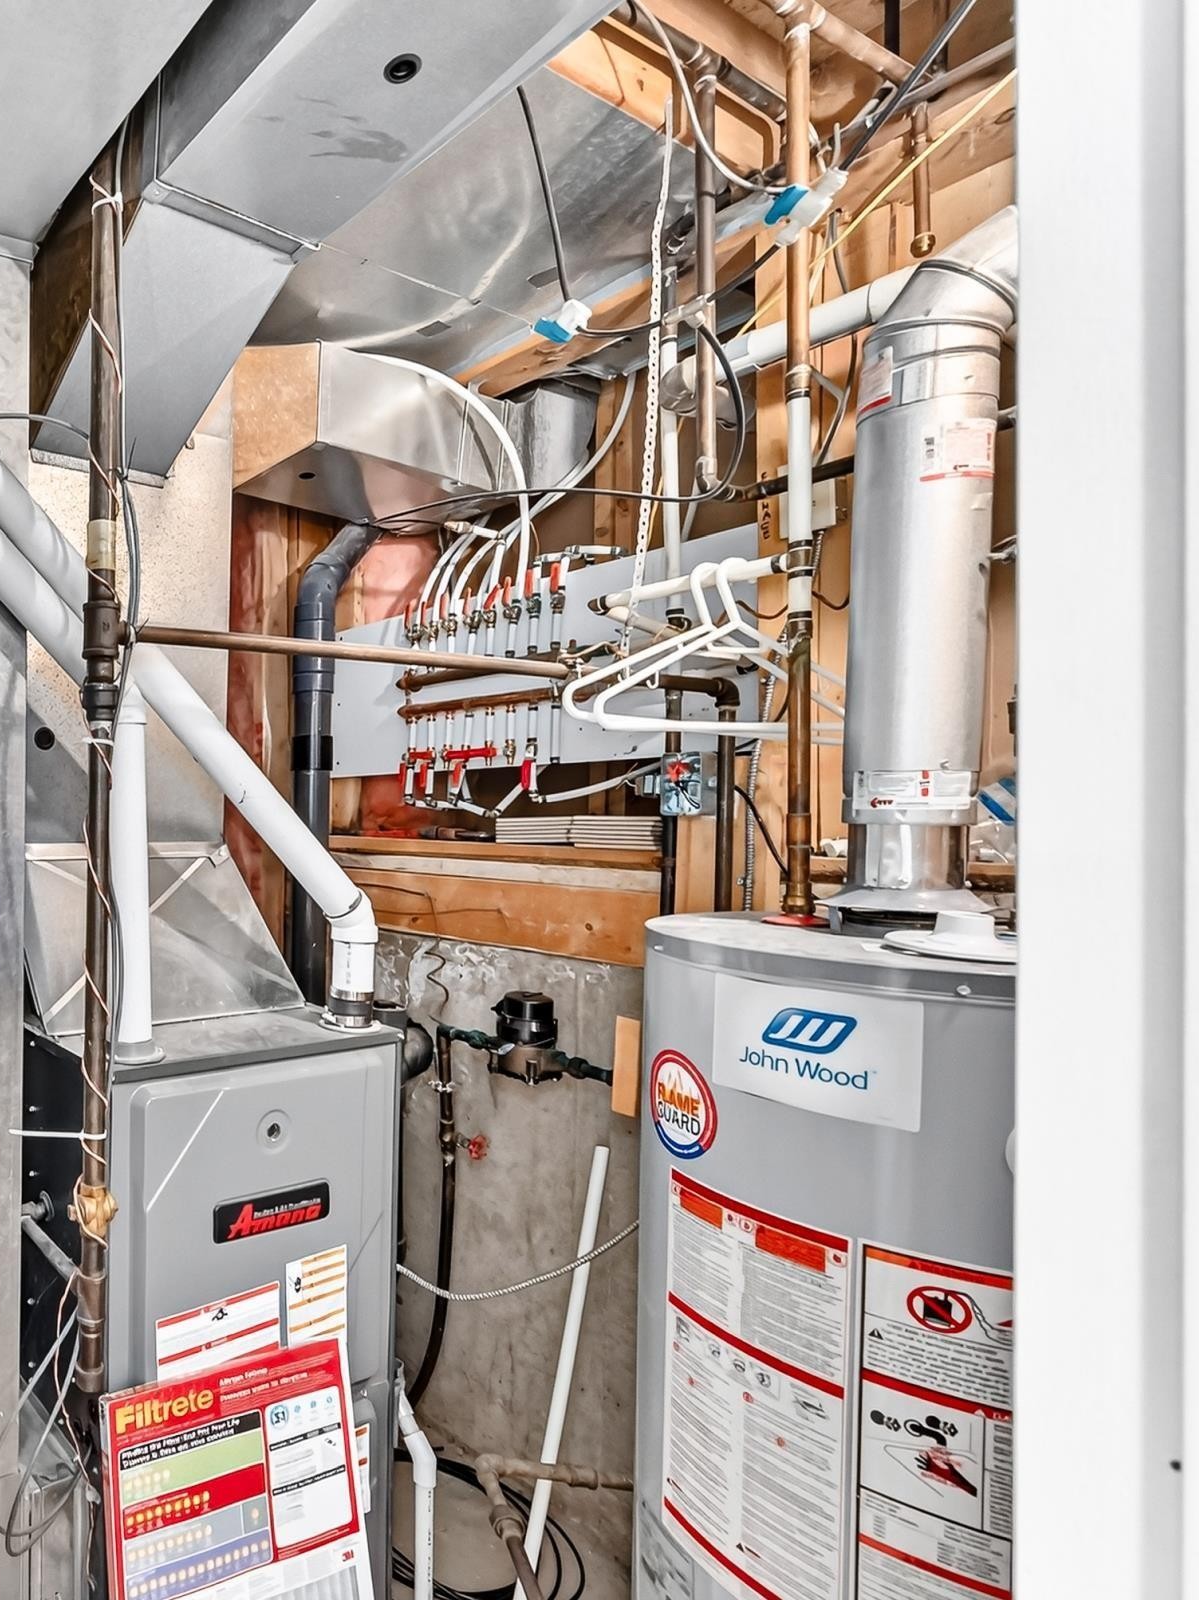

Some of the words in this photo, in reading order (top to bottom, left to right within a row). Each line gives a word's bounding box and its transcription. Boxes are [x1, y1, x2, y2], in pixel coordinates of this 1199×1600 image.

[739, 1045, 789, 1075] John
[794, 1057, 868, 1090] Wood
[657, 1100, 701, 1136] GUARD
[227, 1203, 322, 1240] Amana
[115, 1389, 214, 1434] Filtrete
